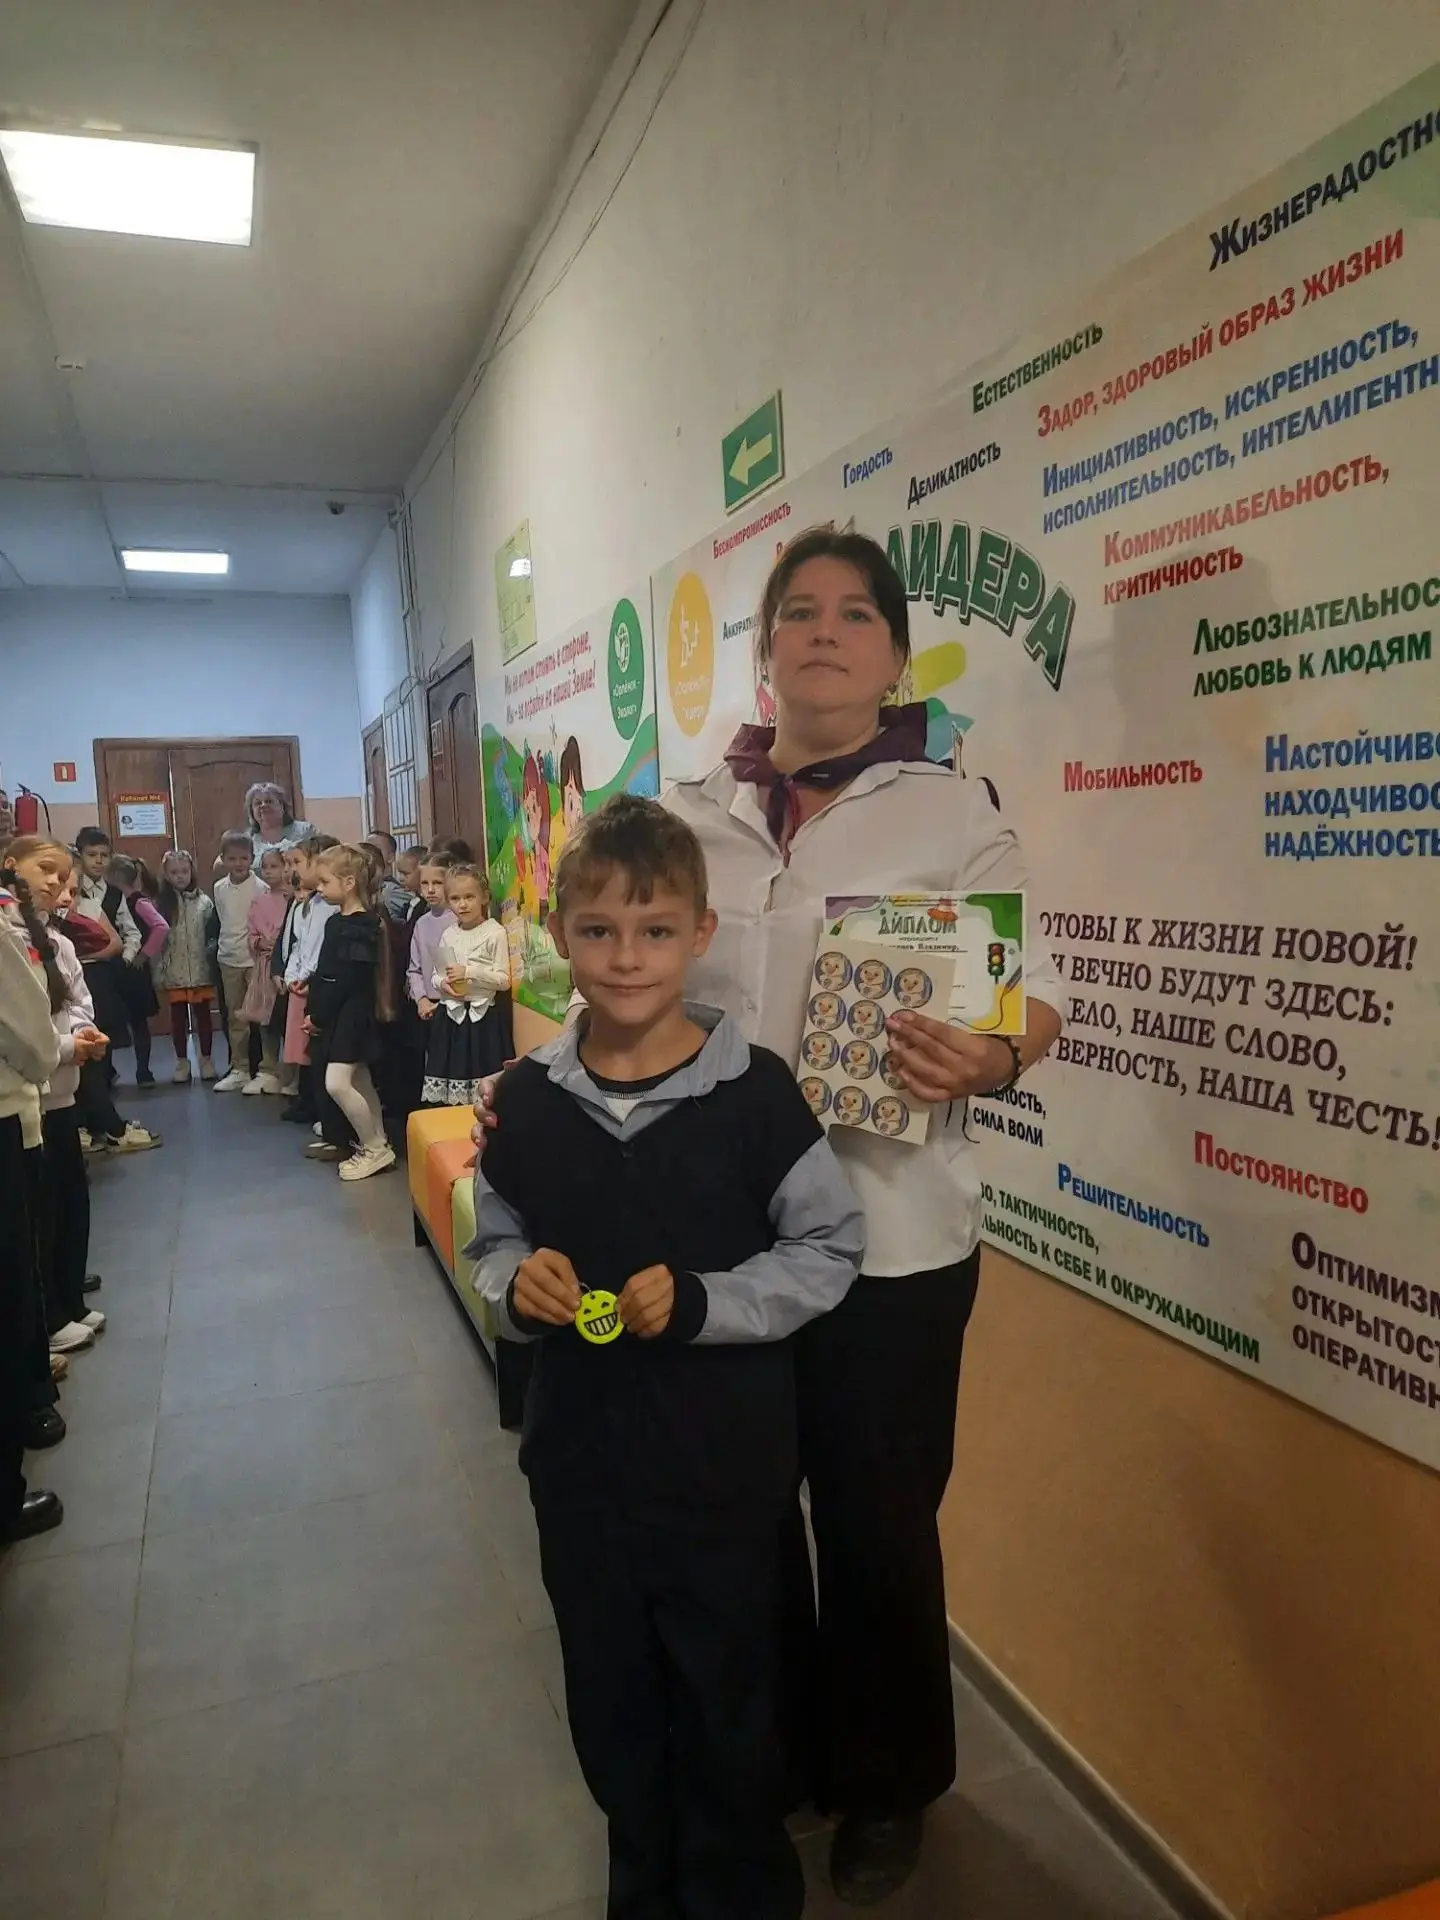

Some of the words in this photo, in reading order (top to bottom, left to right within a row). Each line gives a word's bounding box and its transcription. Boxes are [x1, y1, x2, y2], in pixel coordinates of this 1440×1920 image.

[1209, 108, 1440, 272] ЖИЗНЕРАДОСТН
[1103, 324, 1213, 405] ЗДОРОВЫЙ
[1218, 286, 1296, 347] ОБРАЗ
[1301, 228, 1405, 307] ЖИЗНИ
[1225, 318, 1419, 420] ИСКРЕННОСТЬ,
[1043, 441, 1236, 534] ИСПОЛНИТЕЛЬНОСТЬ,
[883, 516, 1077, 692] ЛИДЕРА
[1104, 545, 1244, 605] КРИТИЧНОСТЬ
[1193, 657, 1293, 697] ЛЮБОВЬ
[1298, 651, 1316, 680] К
[1321, 630, 1432, 675] ЛЮДЯМ
[1265, 728, 1440, 773] НАСТОЙЧИВ
[1039, 911, 1118, 943] ОТОВЫ
[1123, 917, 1143, 945] К
[1148, 919, 1264, 957] ЖИЗНИ
[1271, 921, 1419, 972] НОВОЙ!
[1070, 955, 1152, 992] ВЕЧНО
[1159, 966, 1257, 1008] БУДУТ
[1264, 976, 1395, 1027] ЗДЕСЬ:
[1066, 996, 1122, 1038] ЕЛО,
[1130, 1008, 1216, 1049] НАШЕ
[1224, 1022, 1347, 1080] СЛОВО,
[973, 1107, 1005, 1134] СИЛА
[1008, 1118, 1044, 1148] ВОЛИ
[1056, 1036, 1188, 1097] ВЕРНОСТЬ,
[1197, 1066, 1295, 1116] НАША
[1307, 1088, 1440, 1152] ЧЕСТЬ!
[999, 1190, 1100, 1255] ТАКТИЧНОСТЬ,
[982, 1213, 1038, 1255] ЛЬНОСТЬ
[1041, 1240, 1051, 1262] К
[1054, 1247, 1092, 1283] СЕБЕ
[1095, 1265, 1107, 1290] И
[1110, 1277, 1261, 1364] ОКРУЖАЮЩИМ
